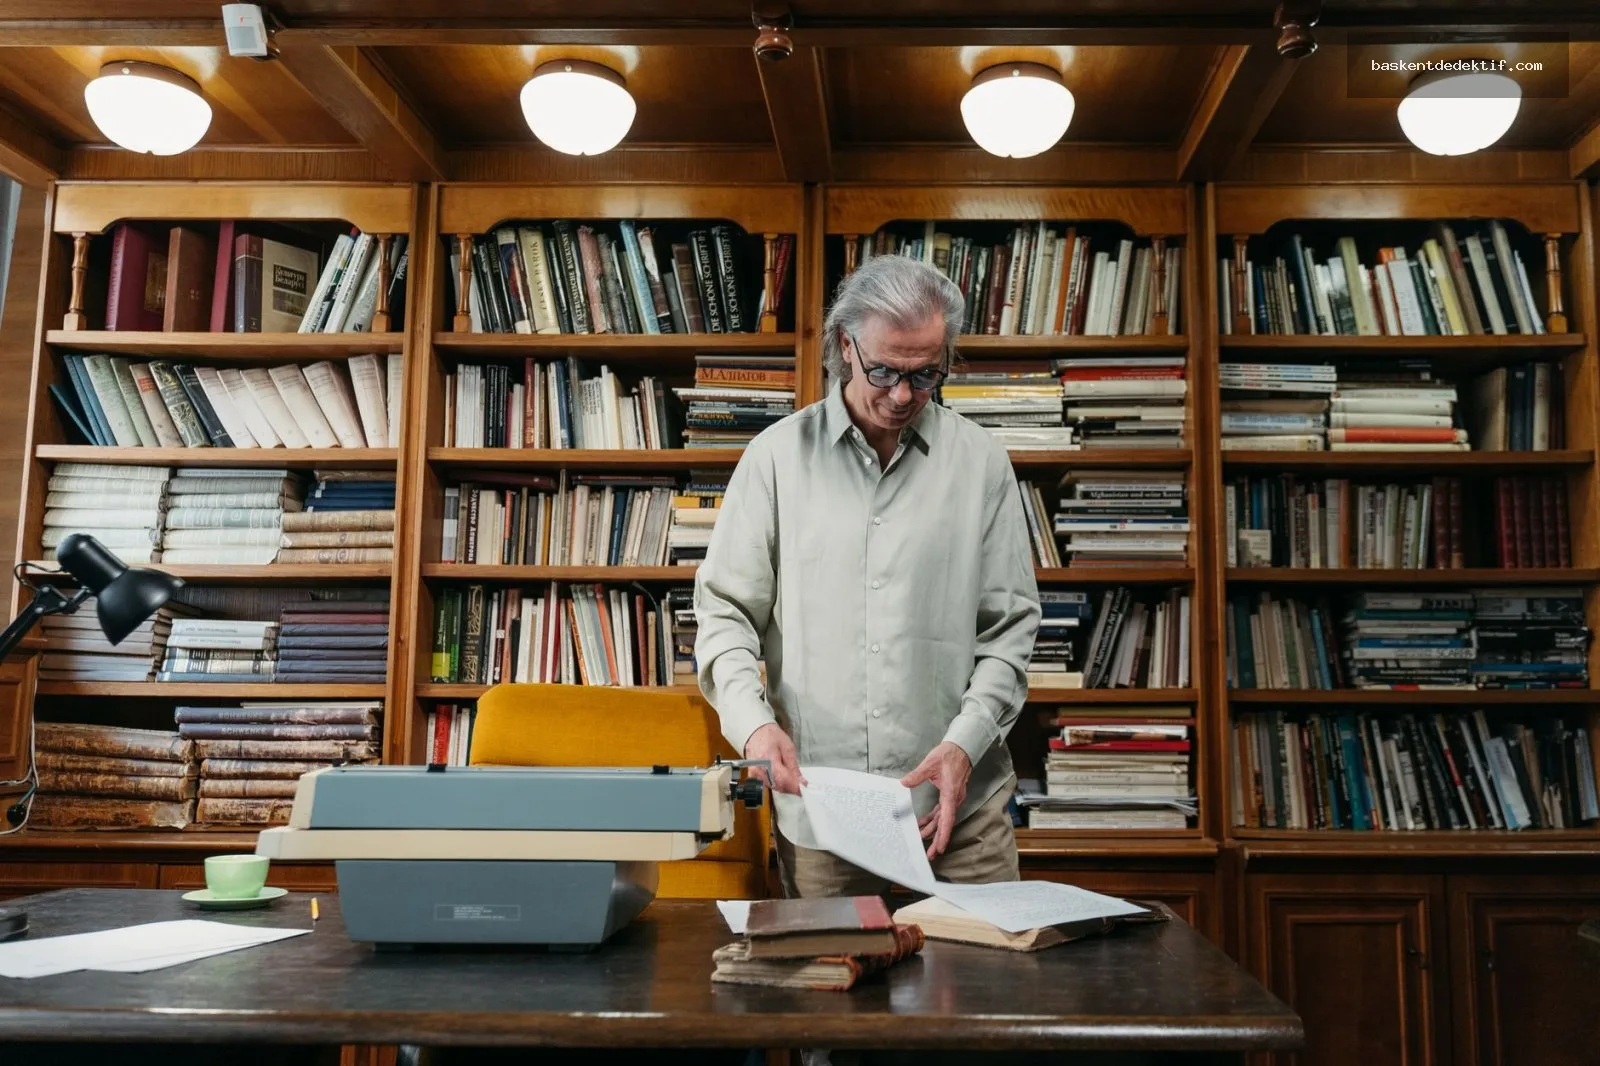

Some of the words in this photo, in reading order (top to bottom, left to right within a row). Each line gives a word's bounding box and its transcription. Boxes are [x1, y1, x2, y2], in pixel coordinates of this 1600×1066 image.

[699, 244, 713, 279] SCHRIFT
[721, 238, 735, 274] SCHRIFT
[711, 318, 721, 332] DIE
[730, 313, 740, 329] DIE
